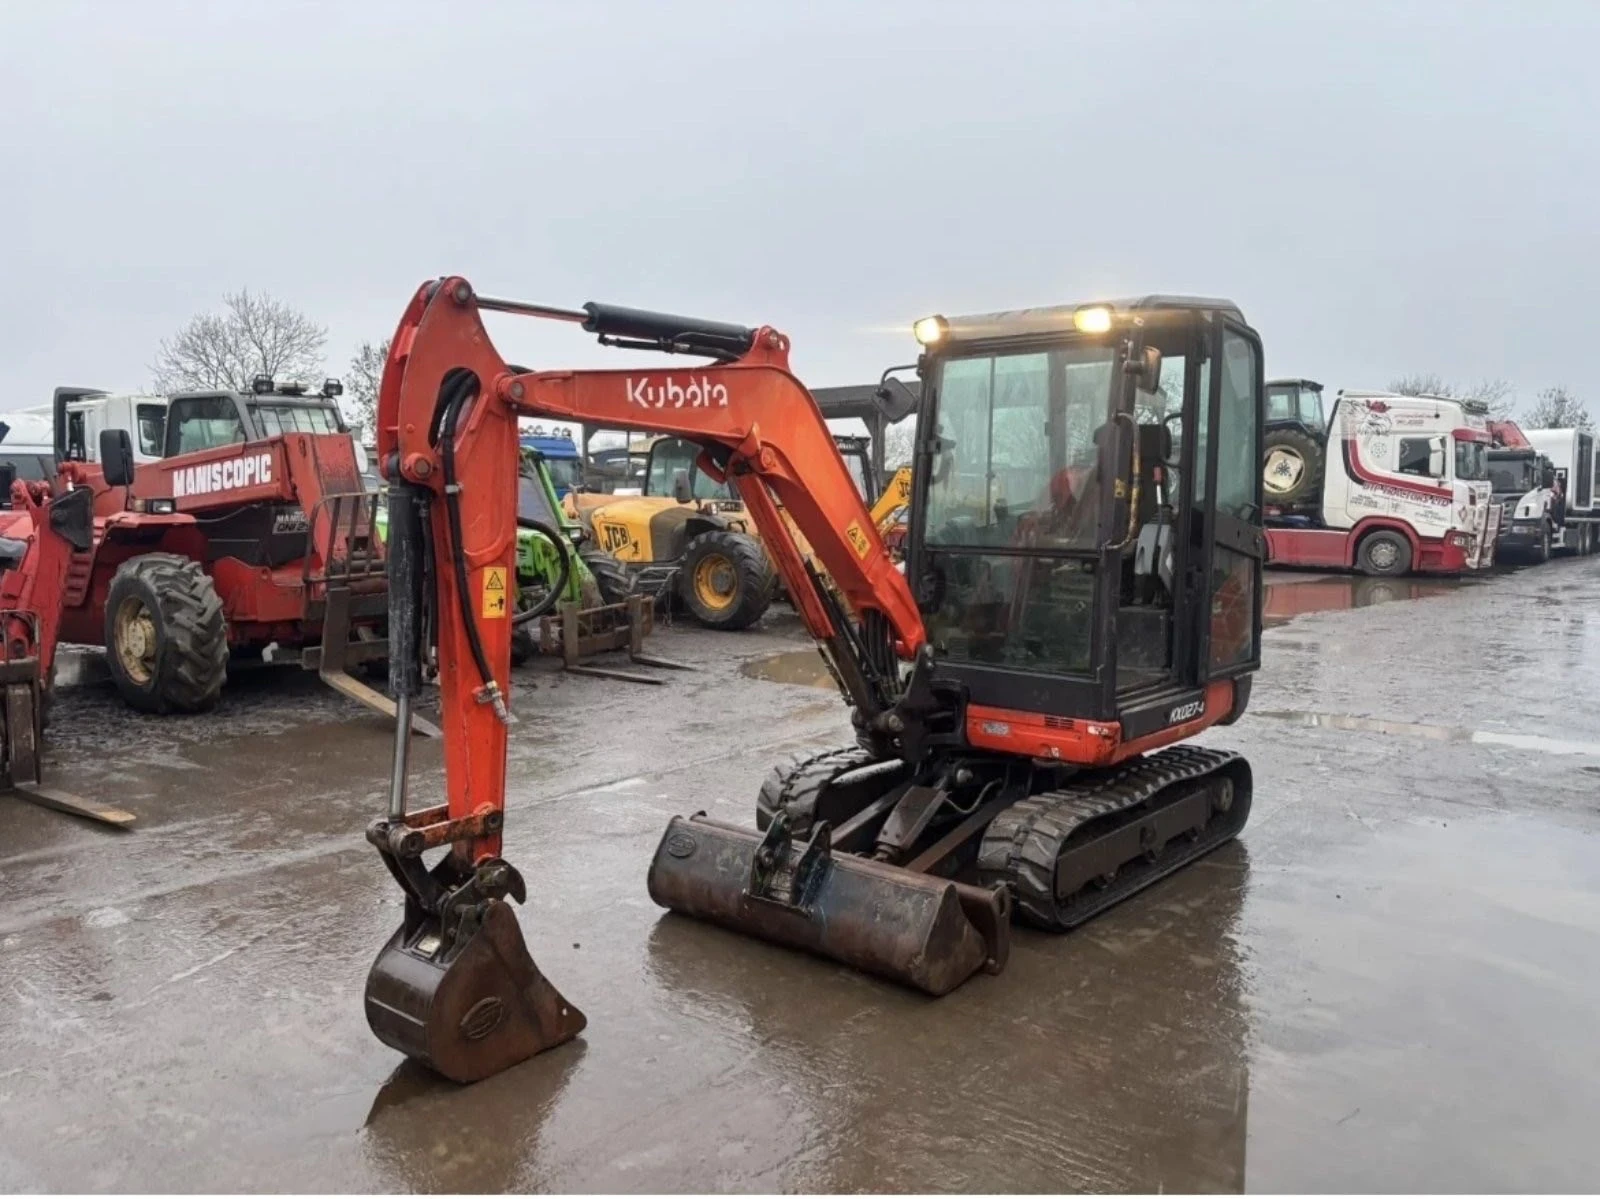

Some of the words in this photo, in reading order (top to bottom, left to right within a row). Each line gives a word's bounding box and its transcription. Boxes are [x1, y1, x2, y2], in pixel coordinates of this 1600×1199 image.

[625, 375, 728, 409] Kubota
[173, 453, 272, 498] MANISCOPIC
[604, 525, 629, 552] JCB
